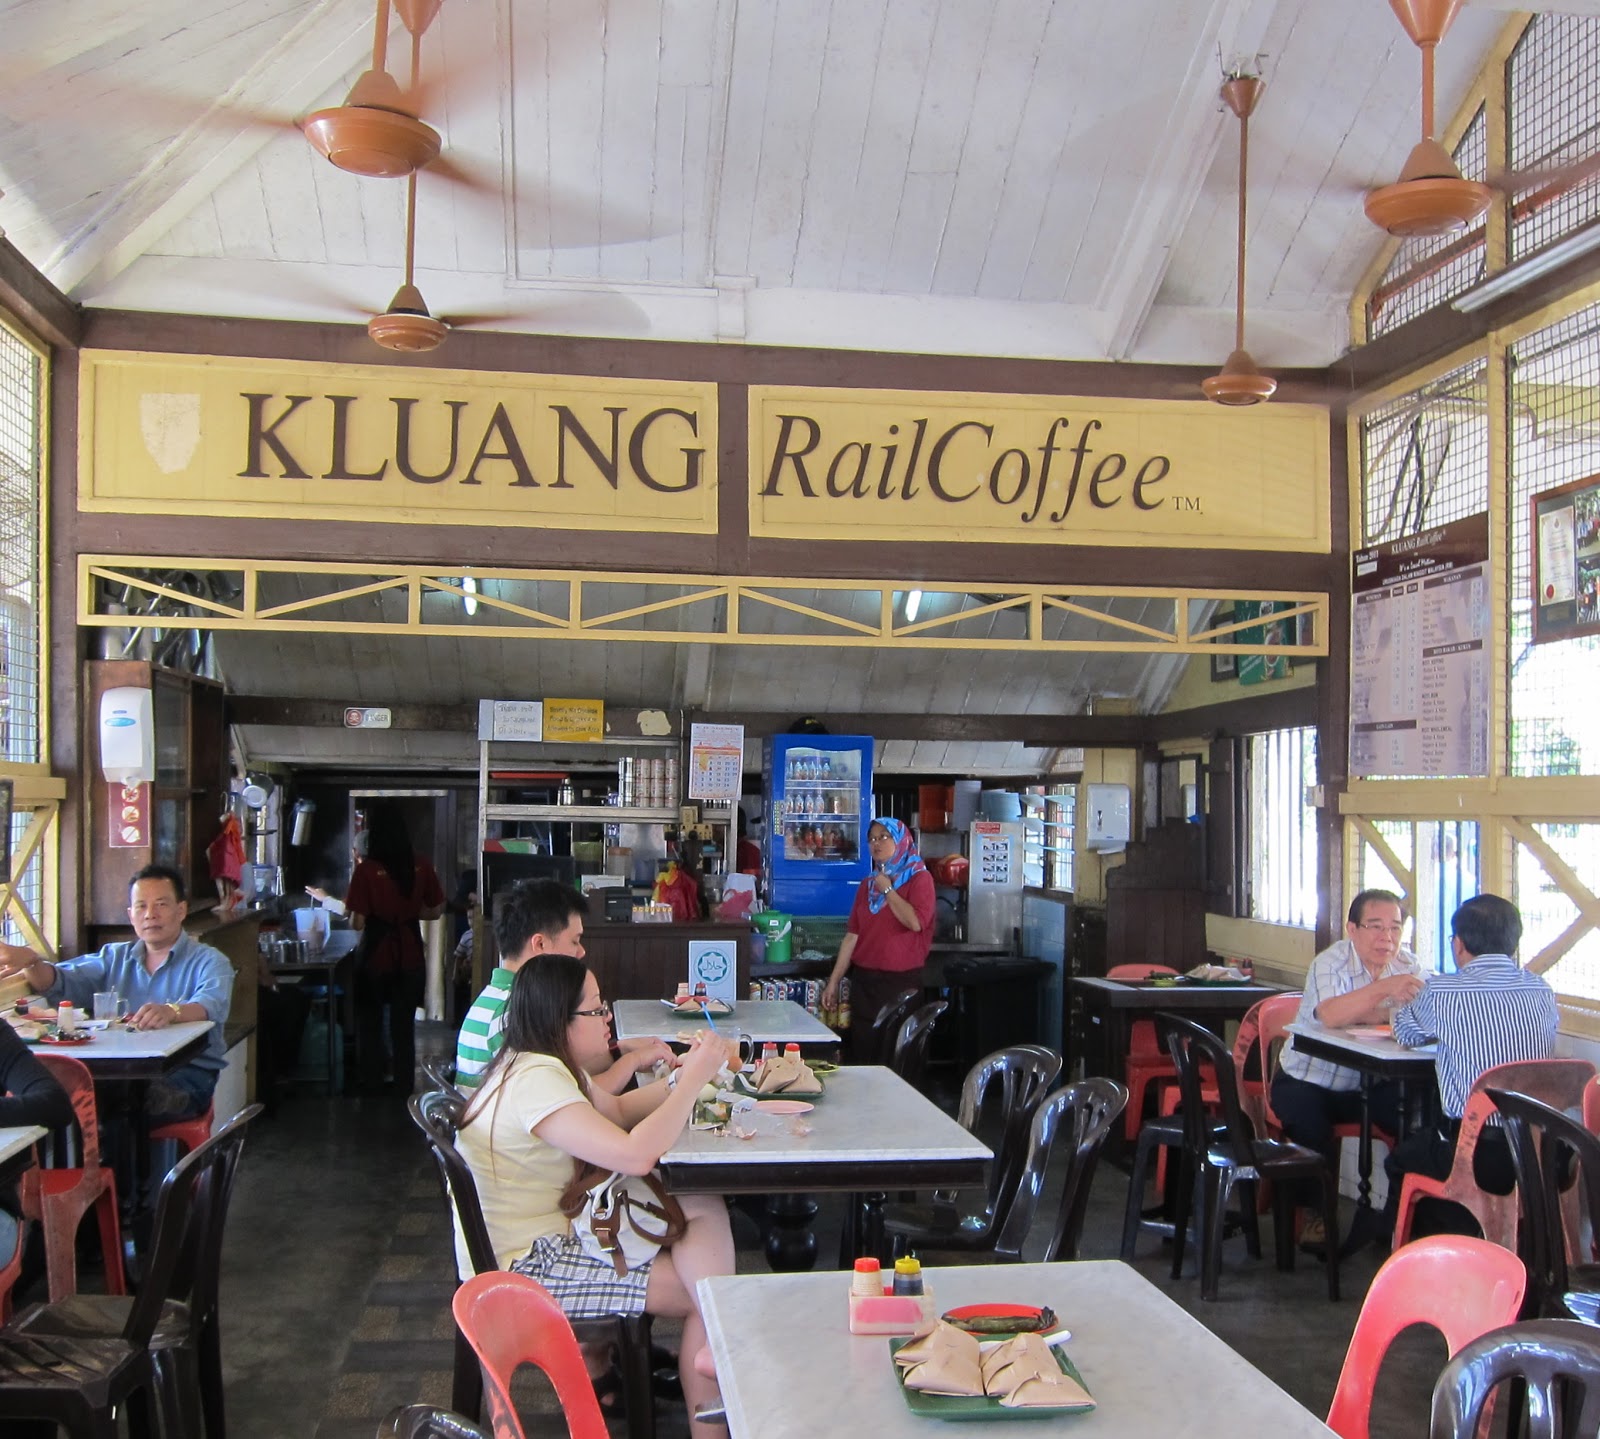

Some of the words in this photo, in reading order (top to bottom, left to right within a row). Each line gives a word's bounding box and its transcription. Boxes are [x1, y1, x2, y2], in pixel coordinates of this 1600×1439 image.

[236, 392, 706, 493] KLUANG
[757, 414, 1171, 523] RailCoffee
[1171, 496, 1200, 511] TM
[365, 713, 389, 722] DANGER
